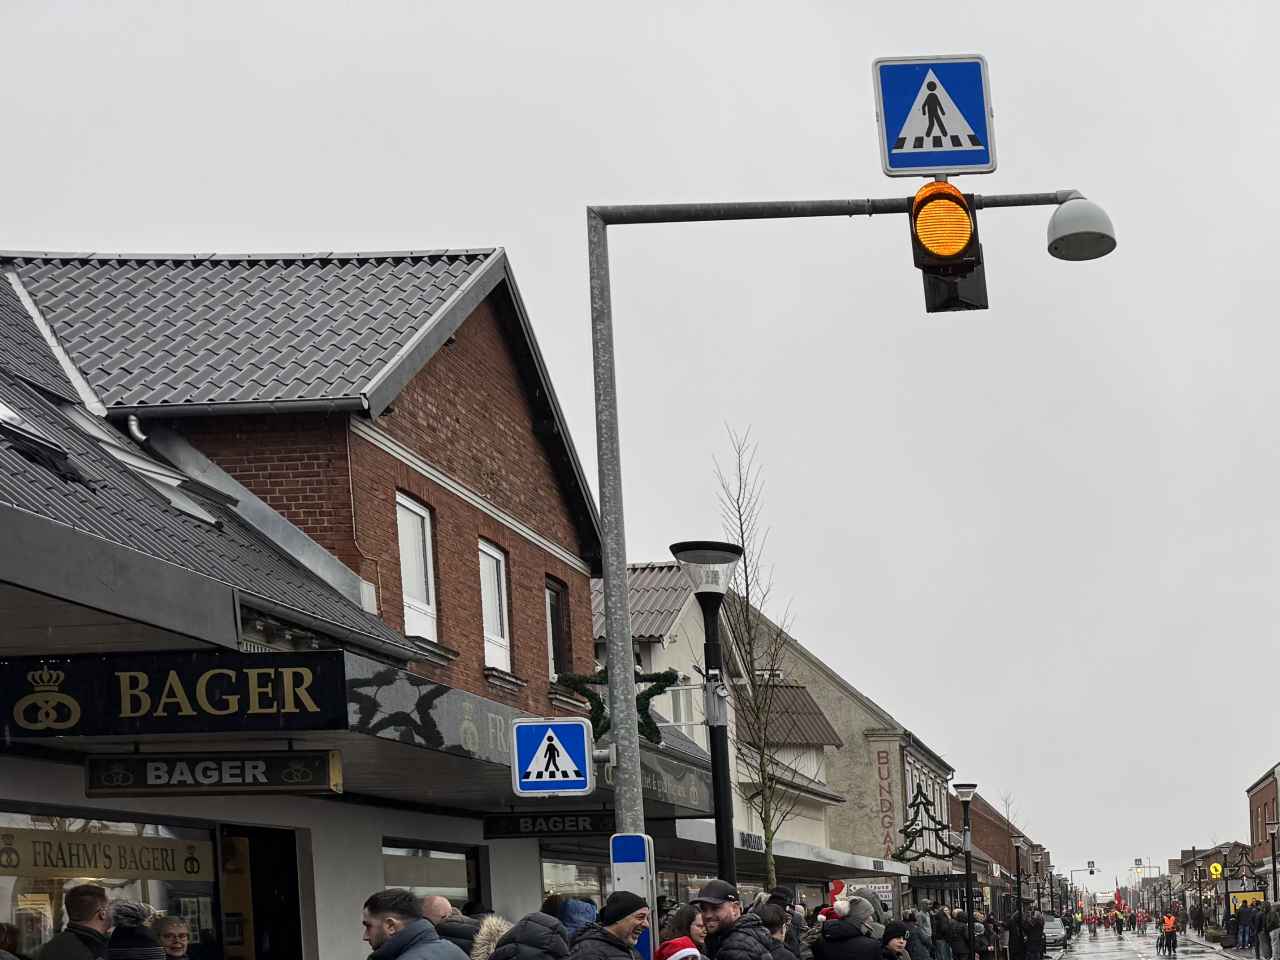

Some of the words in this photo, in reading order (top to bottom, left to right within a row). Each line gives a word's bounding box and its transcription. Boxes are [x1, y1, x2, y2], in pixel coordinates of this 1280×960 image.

[115, 667, 320, 717] BAGER
[146, 760, 268, 784] BAGER
[519, 816, 592, 832] BAGER
[119, 846, 176, 872] BAGERI
